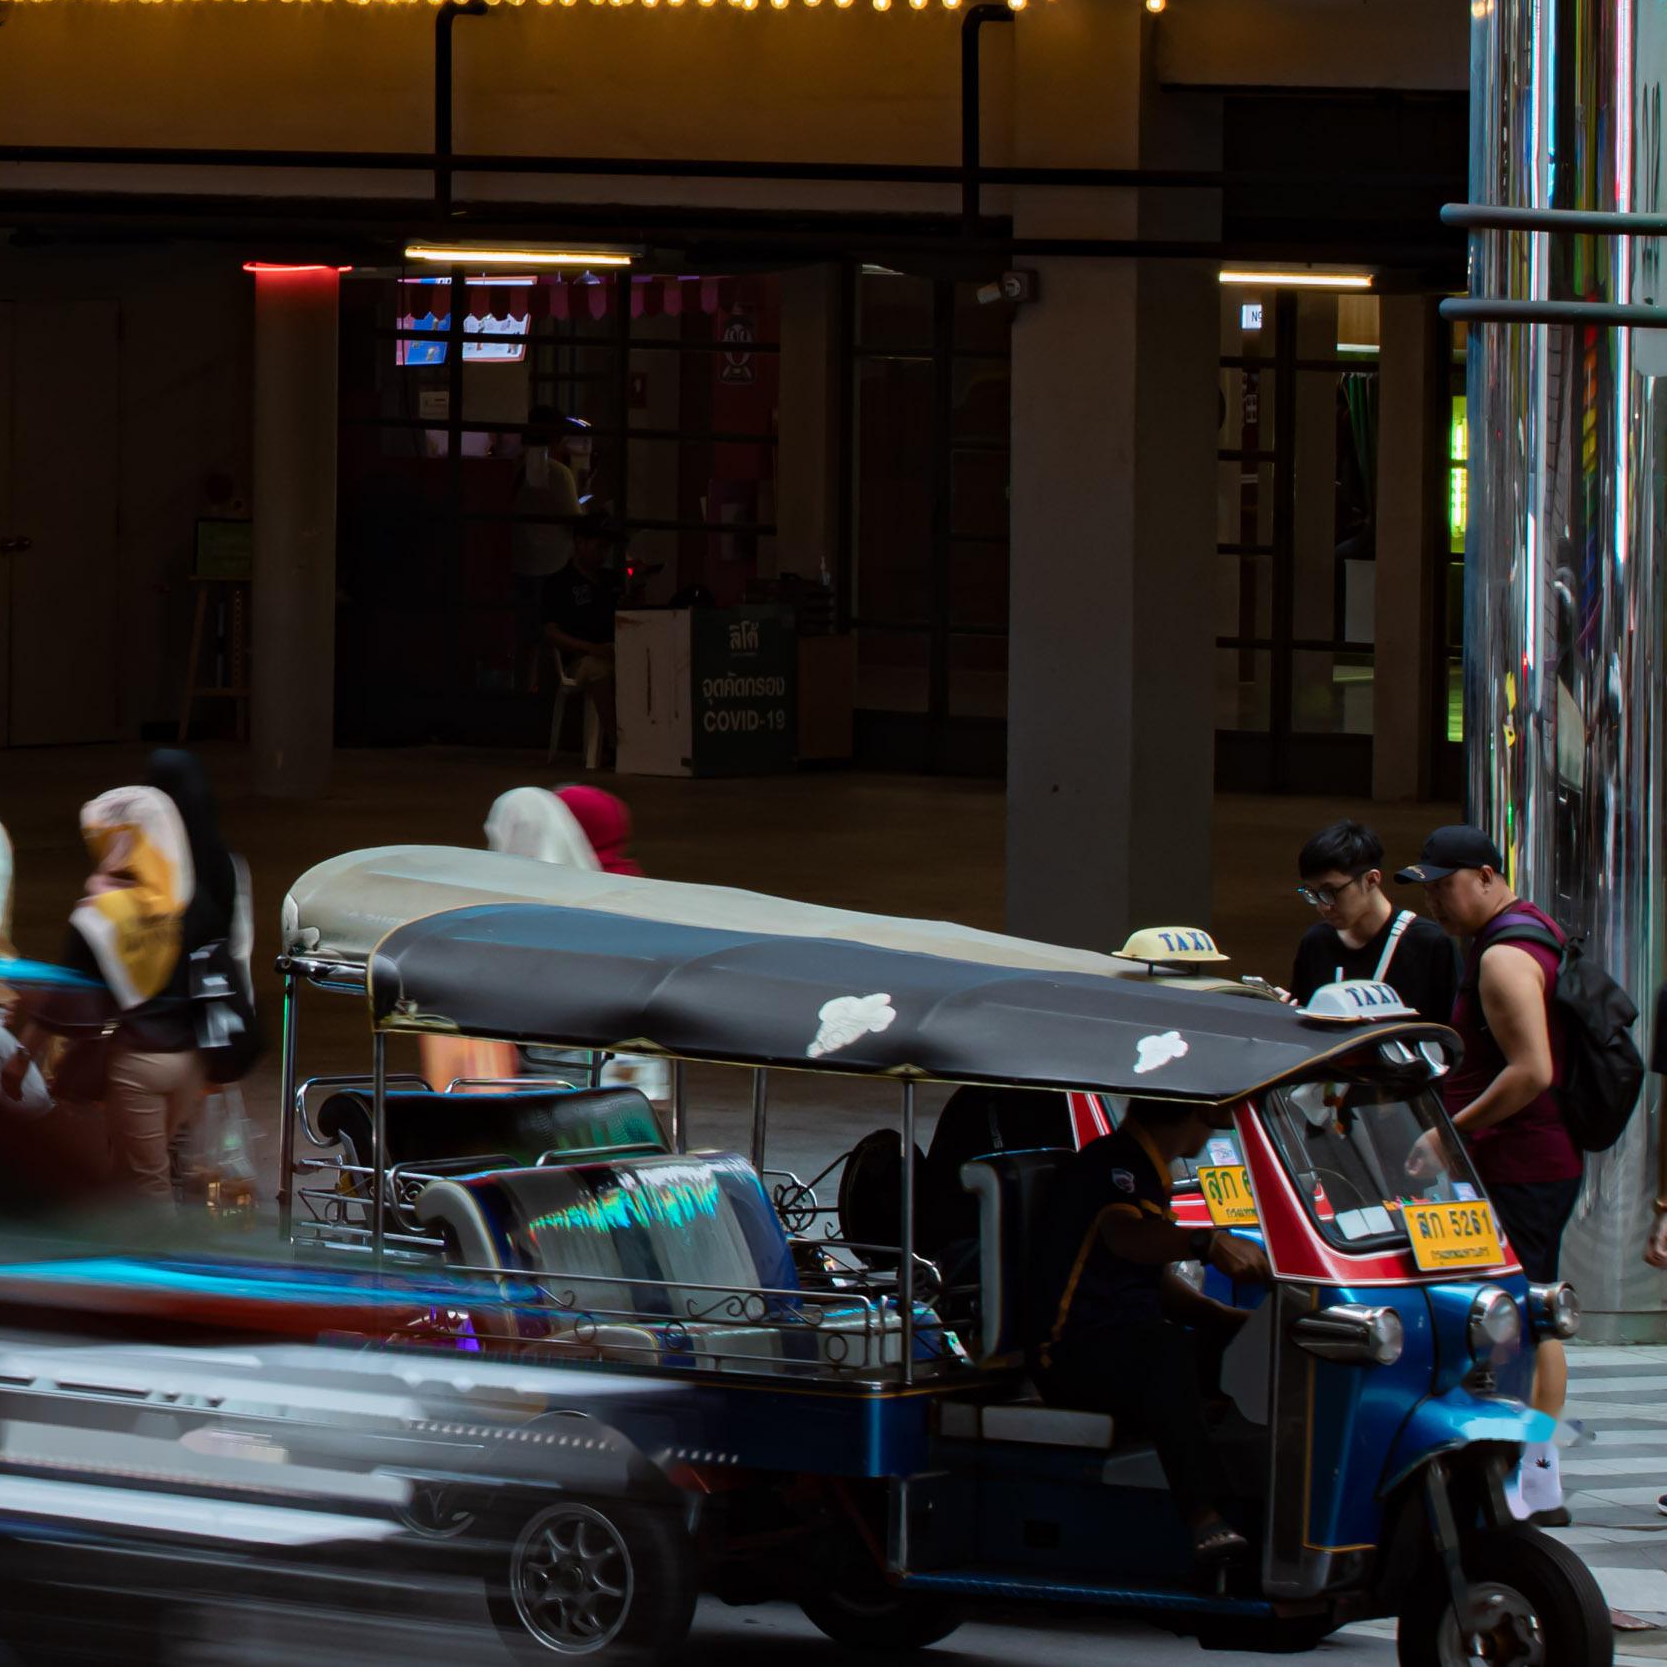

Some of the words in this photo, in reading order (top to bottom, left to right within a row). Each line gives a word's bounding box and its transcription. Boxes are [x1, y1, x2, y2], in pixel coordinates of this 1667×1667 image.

[702, 671, 786, 706] จุดคัดกรอง
[703, 709, 786, 732] COVID-19
[1158, 931, 1216, 952] TAXI
[1345, 986, 1403, 1008] TAXI
[1415, 1212, 1446, 1240] สก
[1451, 1207, 1493, 1237] 5261
